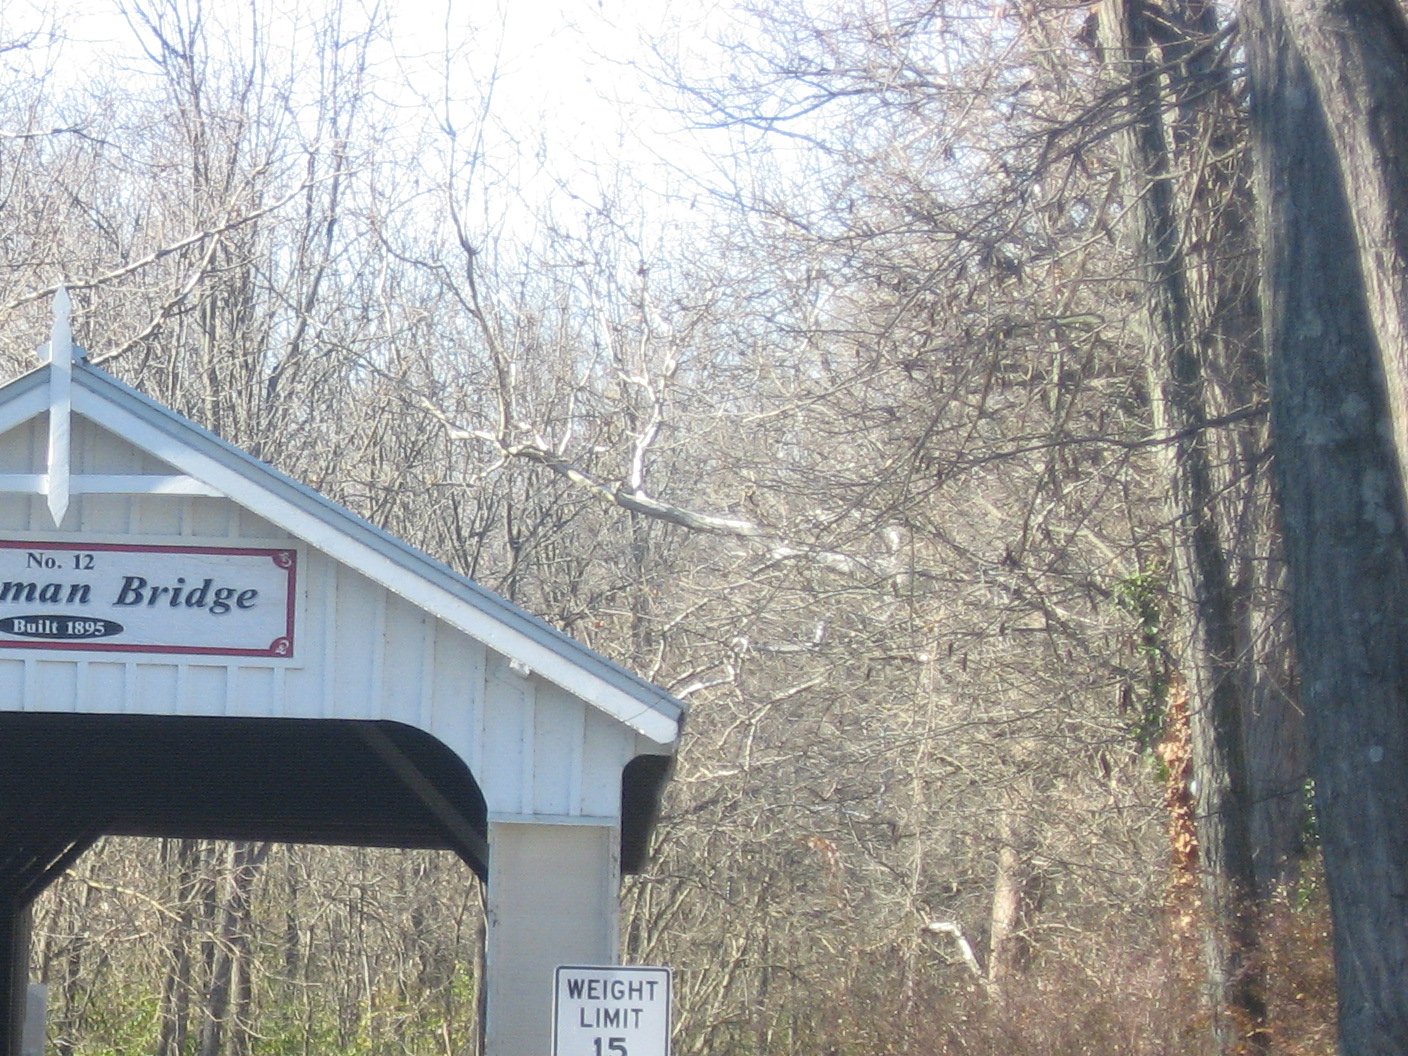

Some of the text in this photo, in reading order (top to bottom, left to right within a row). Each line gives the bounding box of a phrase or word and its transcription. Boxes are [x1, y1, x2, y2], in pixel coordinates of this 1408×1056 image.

[25, 552, 95, 570] No. 12
[112, 575, 259, 615] Bridge
[13, 619, 105, 636] Built 1895
[567, 978, 659, 1001] WEIGHT
[580, 1007, 644, 1029] LIMIT
